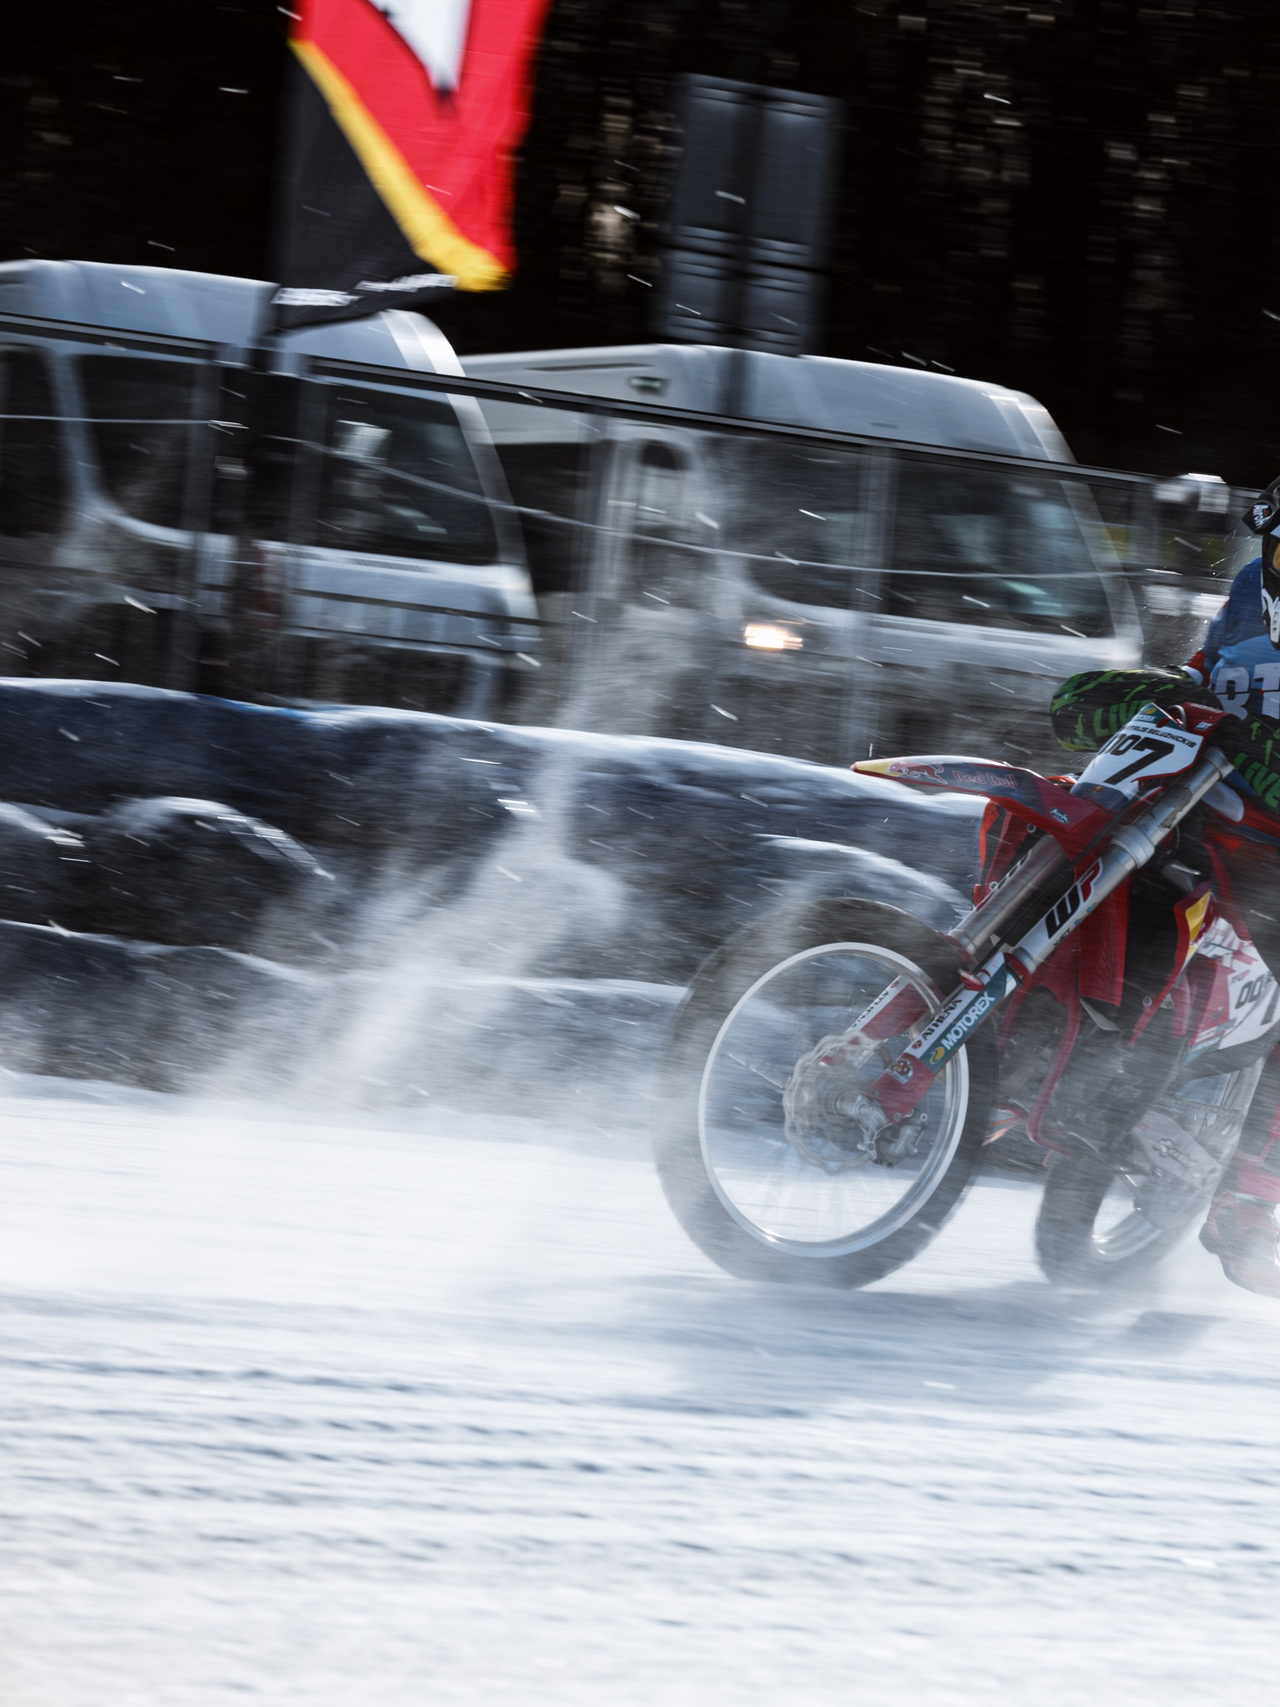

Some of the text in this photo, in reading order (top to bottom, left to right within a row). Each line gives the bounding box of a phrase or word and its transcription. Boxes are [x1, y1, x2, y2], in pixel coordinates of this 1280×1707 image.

[952, 769, 1018, 790] Red Bull
[921, 999, 963, 1041] ATHENA
[940, 991, 996, 1050] MOTOREX
